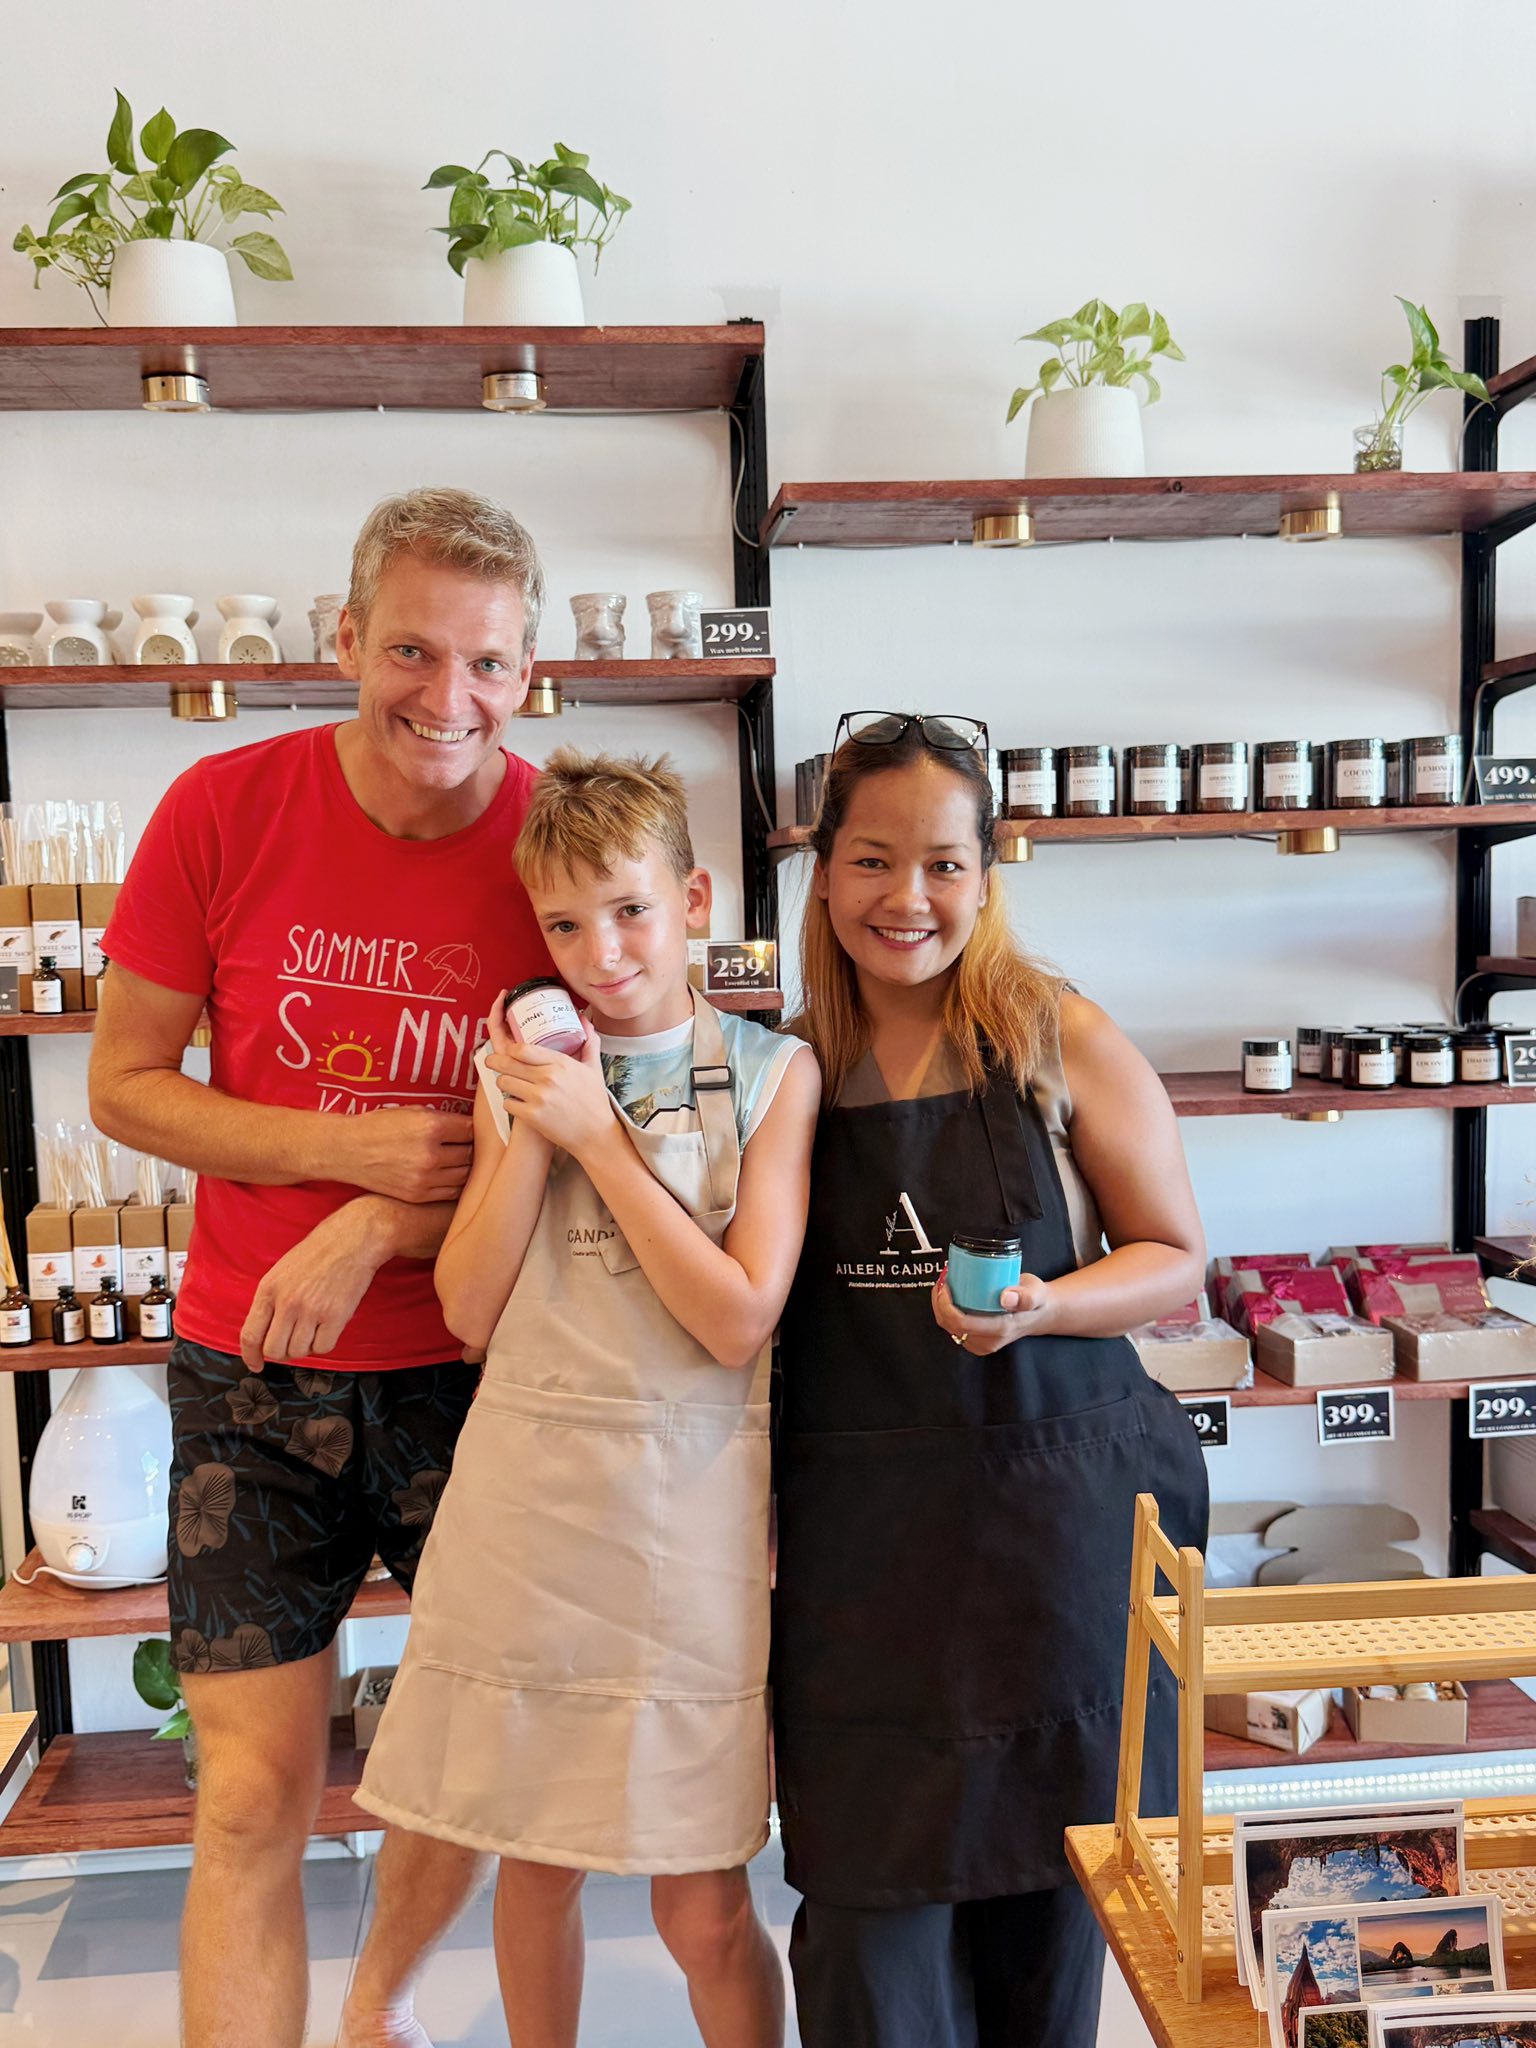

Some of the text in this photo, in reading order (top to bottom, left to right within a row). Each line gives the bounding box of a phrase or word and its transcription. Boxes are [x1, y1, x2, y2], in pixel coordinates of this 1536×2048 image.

[1484, 765, 1536, 786] 499.
[283, 924, 418, 991] SOMMER
[567, 1228, 615, 1244] CAND
[836, 1263, 885, 1276] AILEEN
[1188, 1412, 1225, 1434] 9.-
